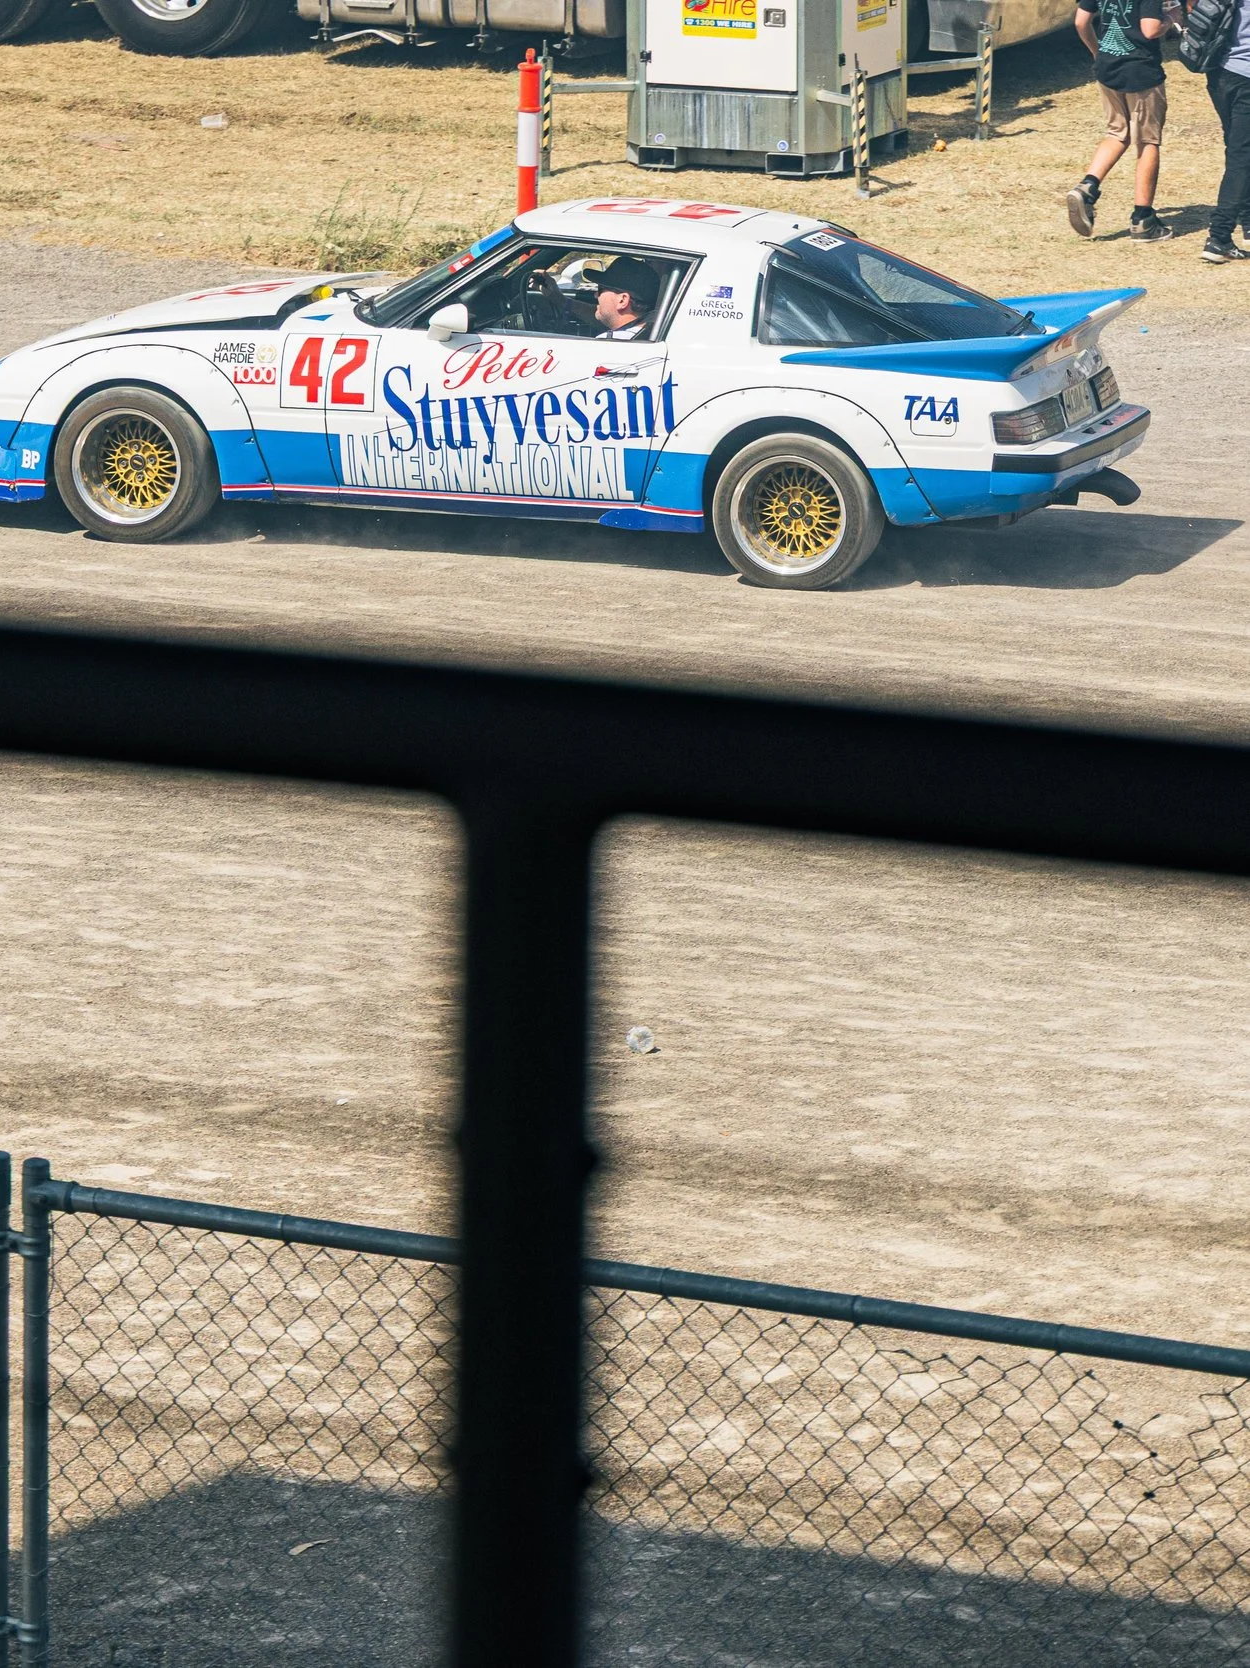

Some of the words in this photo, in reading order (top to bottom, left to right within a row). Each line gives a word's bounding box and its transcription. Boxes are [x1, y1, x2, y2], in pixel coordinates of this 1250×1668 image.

[688, 308, 744, 320] HANSFORD
[700, 300, 735, 310] GREGG
[214, 342, 256, 353] JAMES
[213, 352, 254, 364] HARDIE
[443, 341, 561, 390] Peter
[234, 366, 276, 384] 1000
[289, 337, 369, 405] 42
[382, 364, 679, 465] Stuyvesant
[904, 395, 959, 422] TAA
[21, 449, 40, 469] BP
[342, 433, 634, 501] INTERNATIONAL
